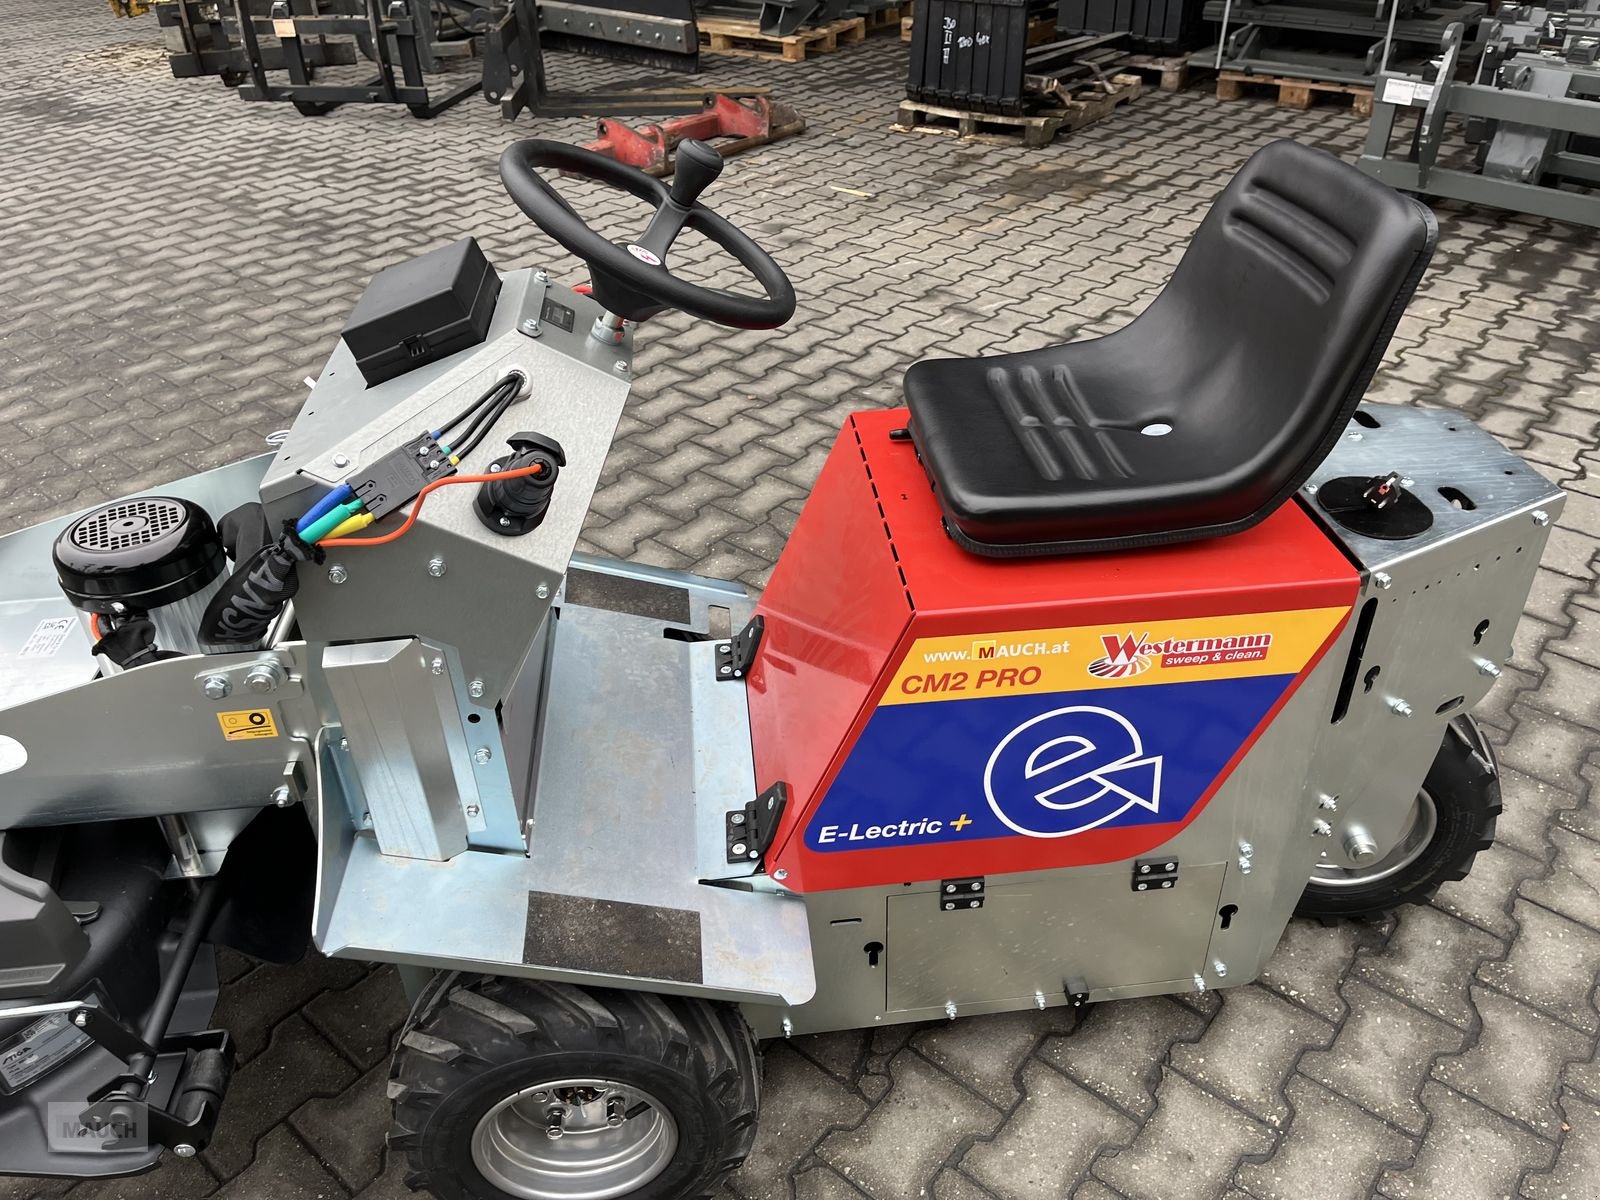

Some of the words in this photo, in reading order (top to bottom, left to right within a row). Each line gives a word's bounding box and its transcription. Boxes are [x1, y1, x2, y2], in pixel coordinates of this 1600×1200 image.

[923, 640, 1071, 663] www.MAUCH.at
[1100, 631, 1272, 664] Westermann
[1165, 654, 1208, 666] sweep
[1212, 652, 1222, 662] &
[1225, 649, 1263, 661] clean.
[901, 671, 968, 695] CM2
[976, 665, 1042, 689] PRO
[818, 817, 943, 844] E-Lectric
